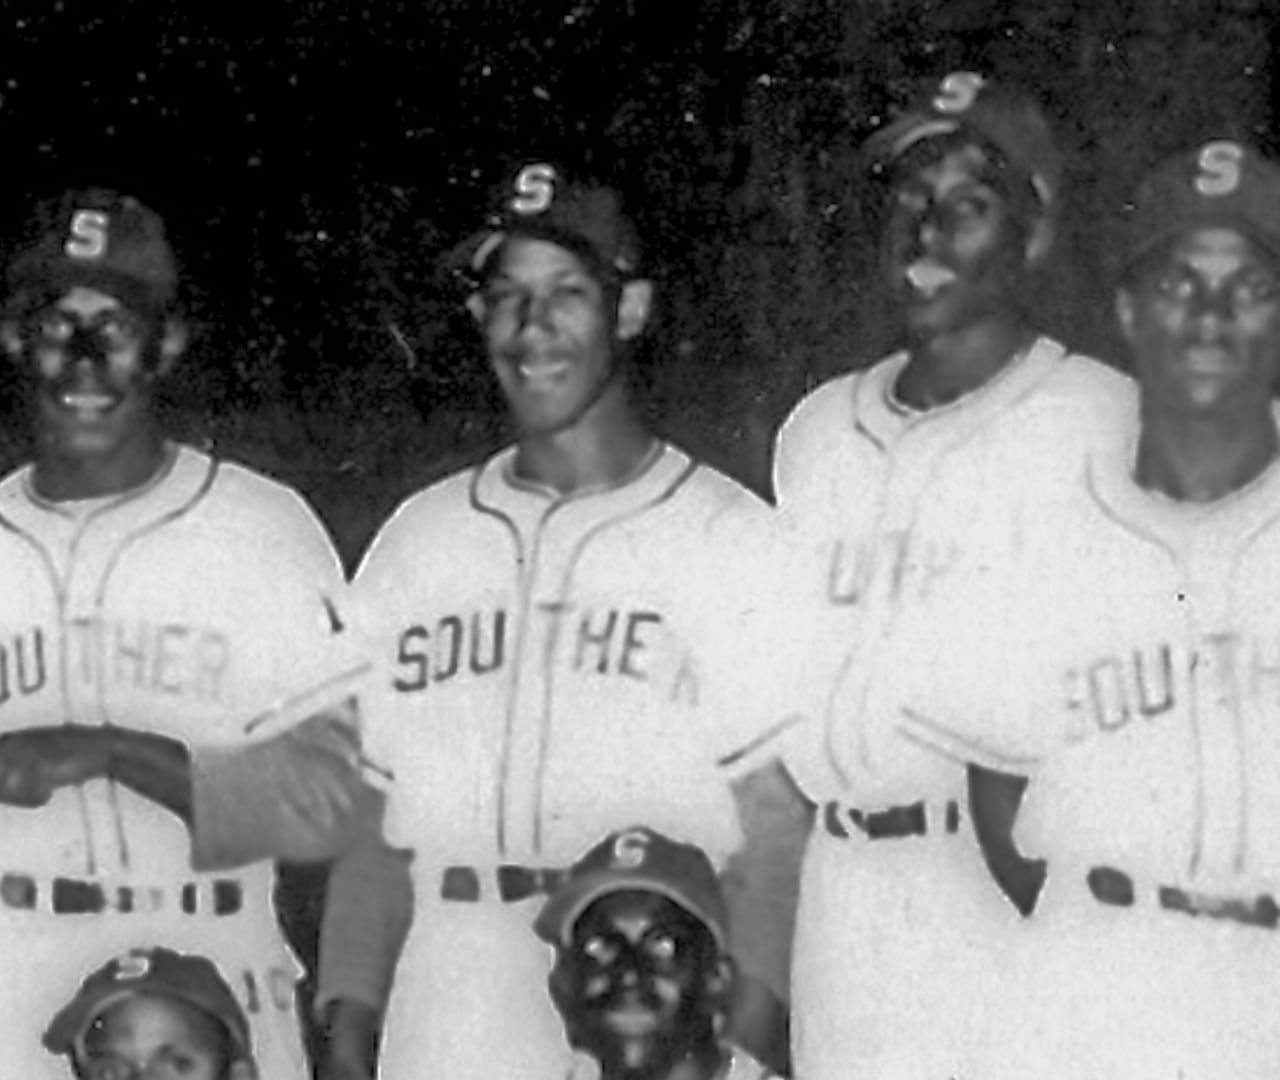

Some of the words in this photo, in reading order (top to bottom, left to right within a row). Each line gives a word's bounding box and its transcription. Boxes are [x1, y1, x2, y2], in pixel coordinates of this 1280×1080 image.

[932, 70, 985, 112] S
[512, 163, 556, 213] S
[1194, 140, 1243, 195] S
[65, 209, 108, 257] S
[612, 830, 650, 868] S
